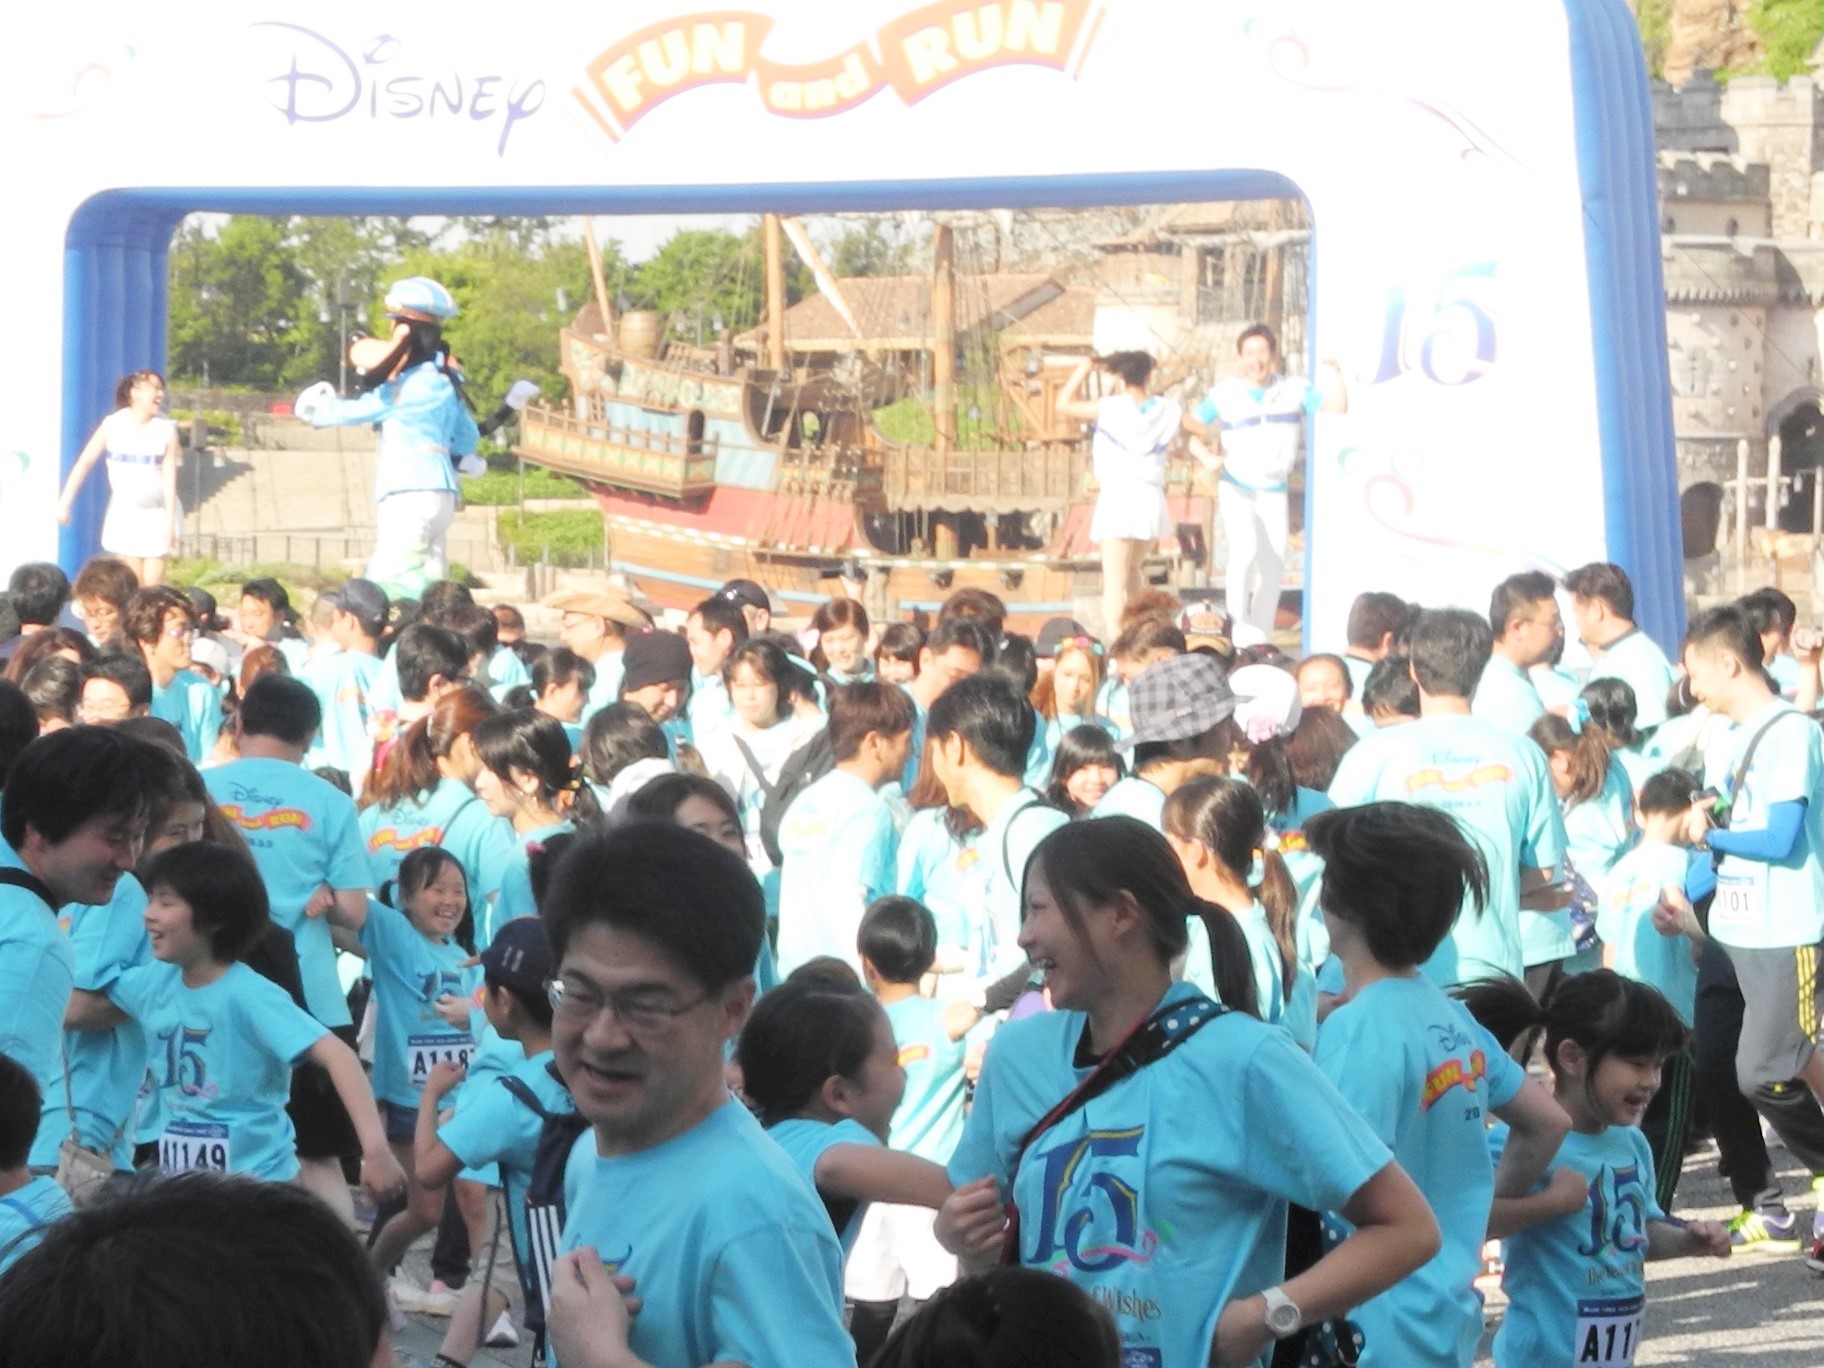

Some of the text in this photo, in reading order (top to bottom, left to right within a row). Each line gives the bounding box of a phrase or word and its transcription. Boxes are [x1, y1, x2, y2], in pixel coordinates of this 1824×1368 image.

[601, 0, 1066, 113] FUN and RUN
[1368, 258, 1499, 386] 15
[157, 1022, 214, 1097] 15
[413, 1048, 475, 1081] A118
[1024, 1122, 1146, 1274] 15
[1578, 1157, 1643, 1256] 15
